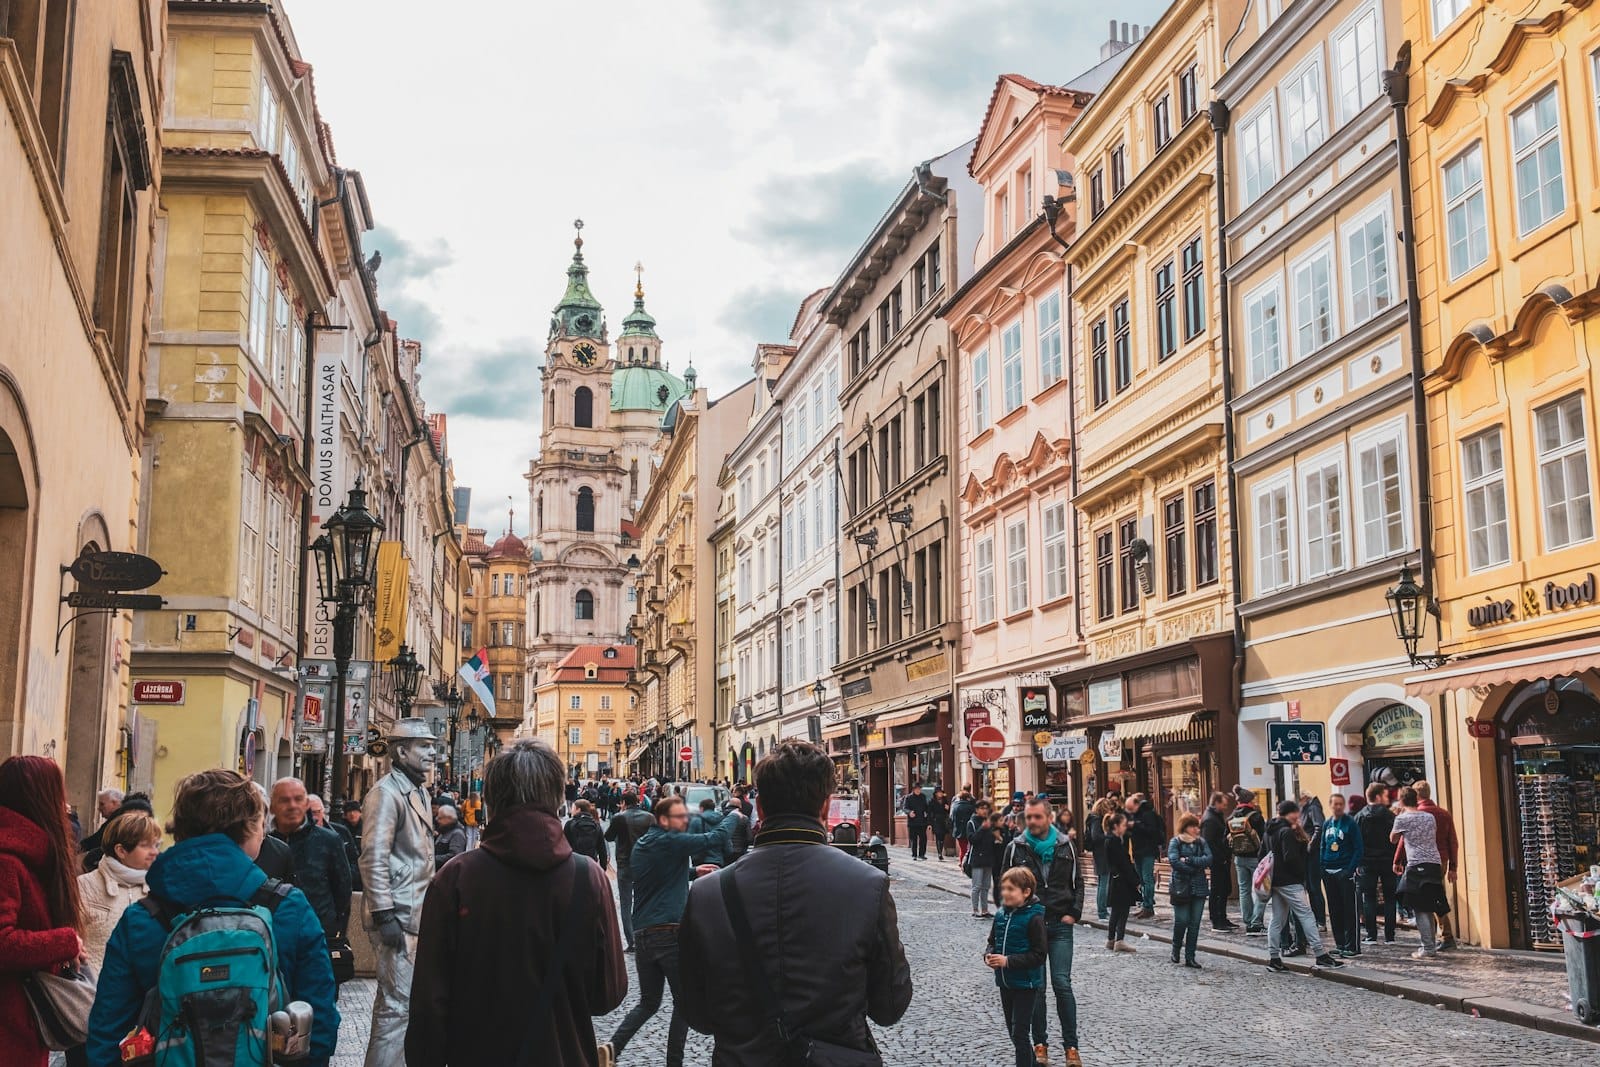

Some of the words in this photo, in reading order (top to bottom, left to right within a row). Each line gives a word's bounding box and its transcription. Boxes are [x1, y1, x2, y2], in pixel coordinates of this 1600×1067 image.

[320, 364, 335, 445] BALTHASAR
[318, 450, 333, 508] DOMUS
[382, 569, 392, 623] RESTAURACE
[1467, 595, 1515, 628] wine
[1522, 588, 1541, 617] &
[1544, 572, 1597, 611] food
[142, 684, 173, 693] LÁZEŇSKÁ
[1372, 705, 1414, 734] SOUVENIR
[1045, 746, 1076, 760] CAFE
